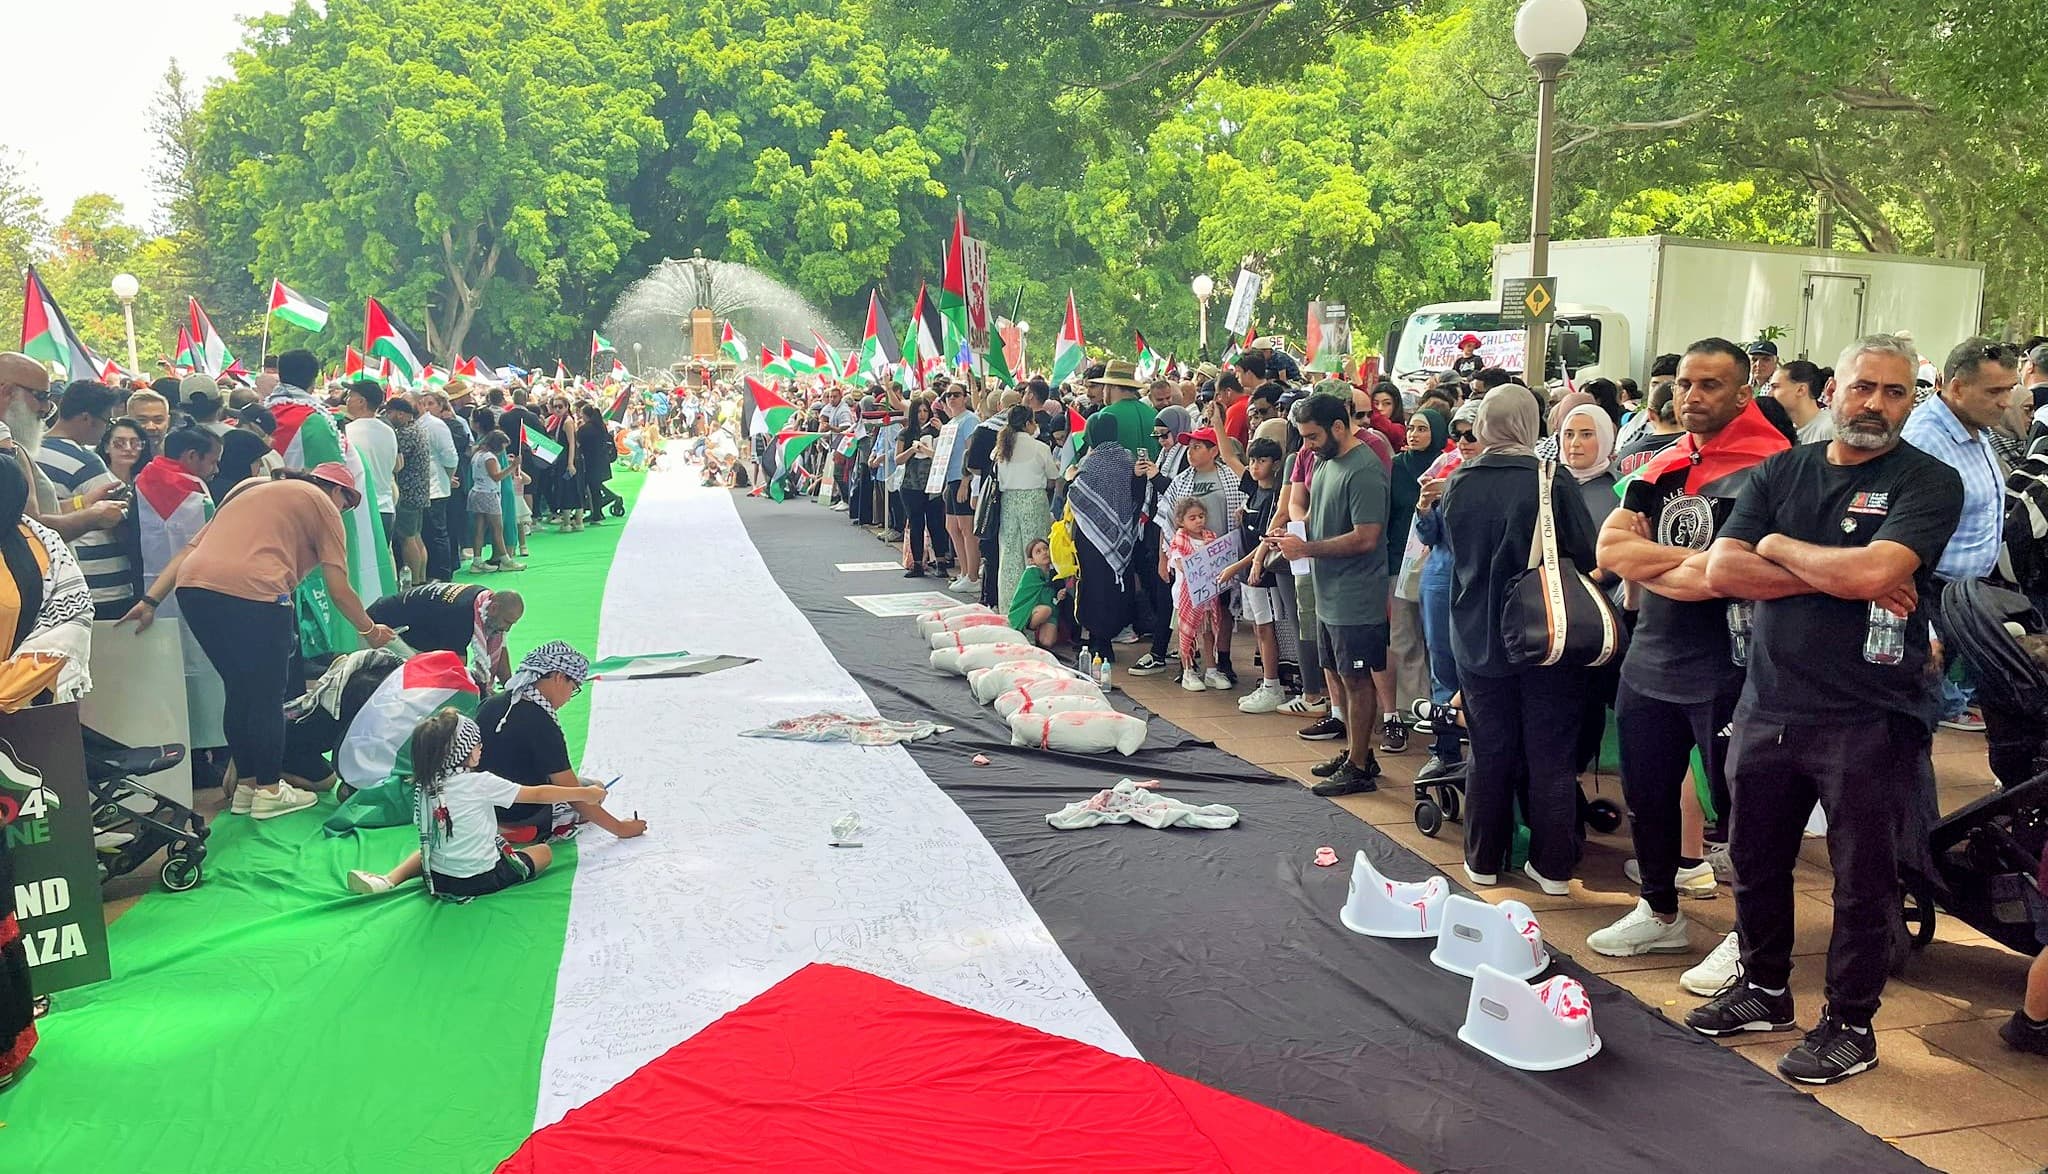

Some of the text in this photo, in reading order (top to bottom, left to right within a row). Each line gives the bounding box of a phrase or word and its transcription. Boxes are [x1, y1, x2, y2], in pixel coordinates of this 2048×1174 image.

[1480, 333, 1526, 345] CHILDRE
[1206, 538, 1232, 559] BEEN
[1188, 564, 1207, 584] ONE
[1193, 584, 1210, 601] 75
[13, 877, 71, 921] ND
